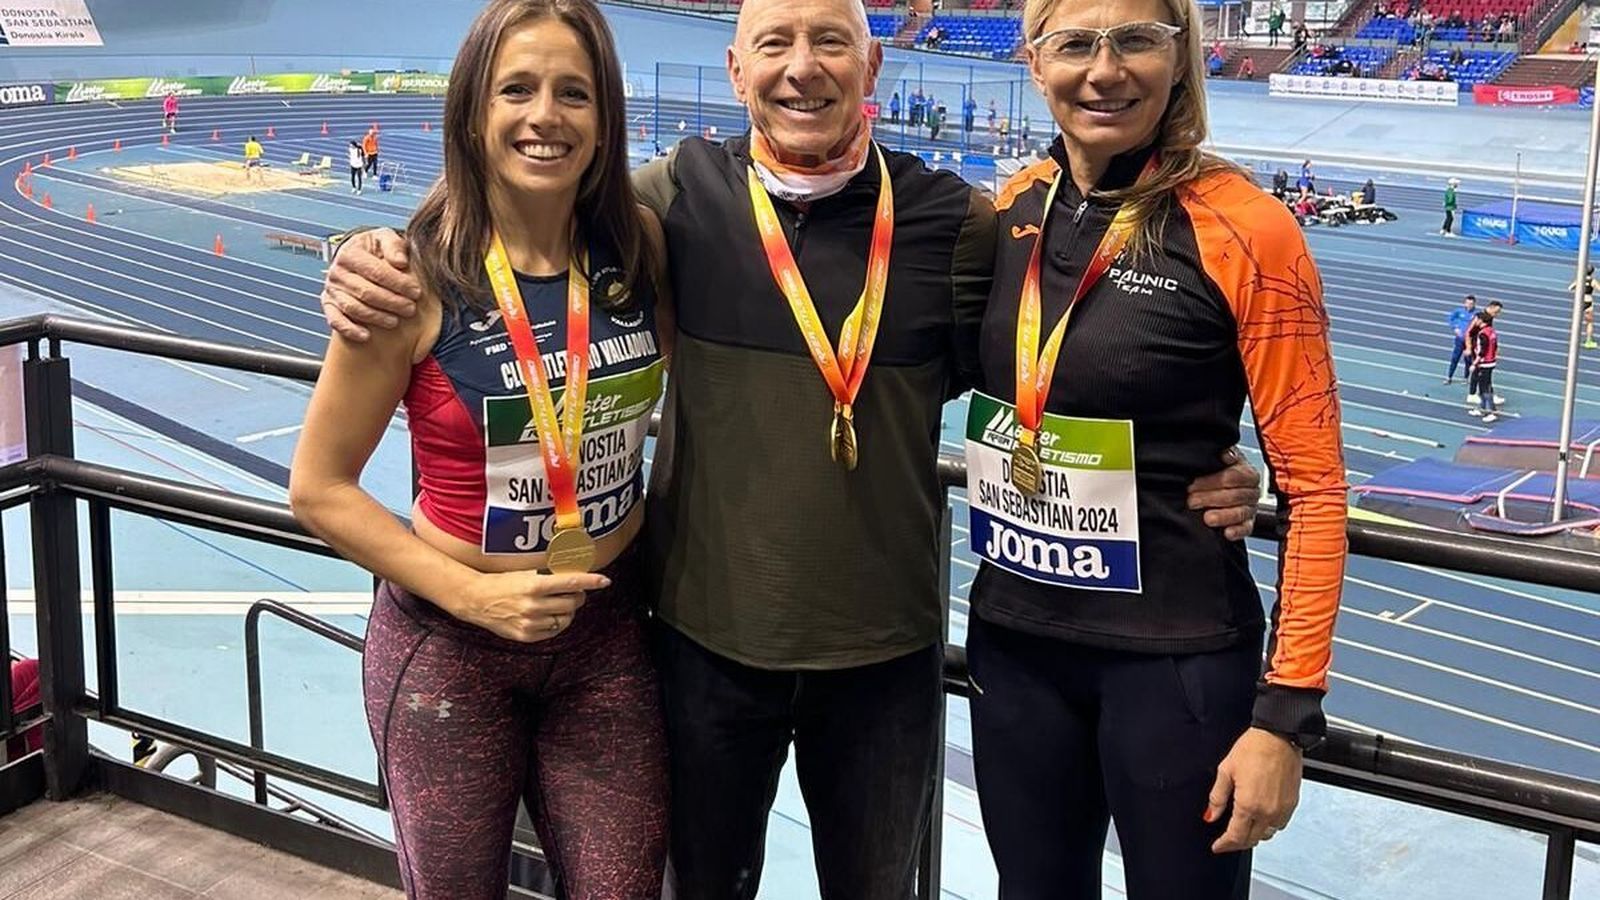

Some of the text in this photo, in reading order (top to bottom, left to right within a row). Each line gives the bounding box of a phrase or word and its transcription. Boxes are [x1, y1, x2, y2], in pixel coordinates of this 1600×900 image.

[1, 9, 58, 18] DONOSTIA
[5, 19, 92, 28] SAN SEBASTIAN
[1109, 268, 1178, 291] PAUNIC
[578, 428, 627, 464] NOSTIA
[508, 477, 543, 504] SAN
[979, 479, 1119, 533] SAN SEBASTIAN 2024
